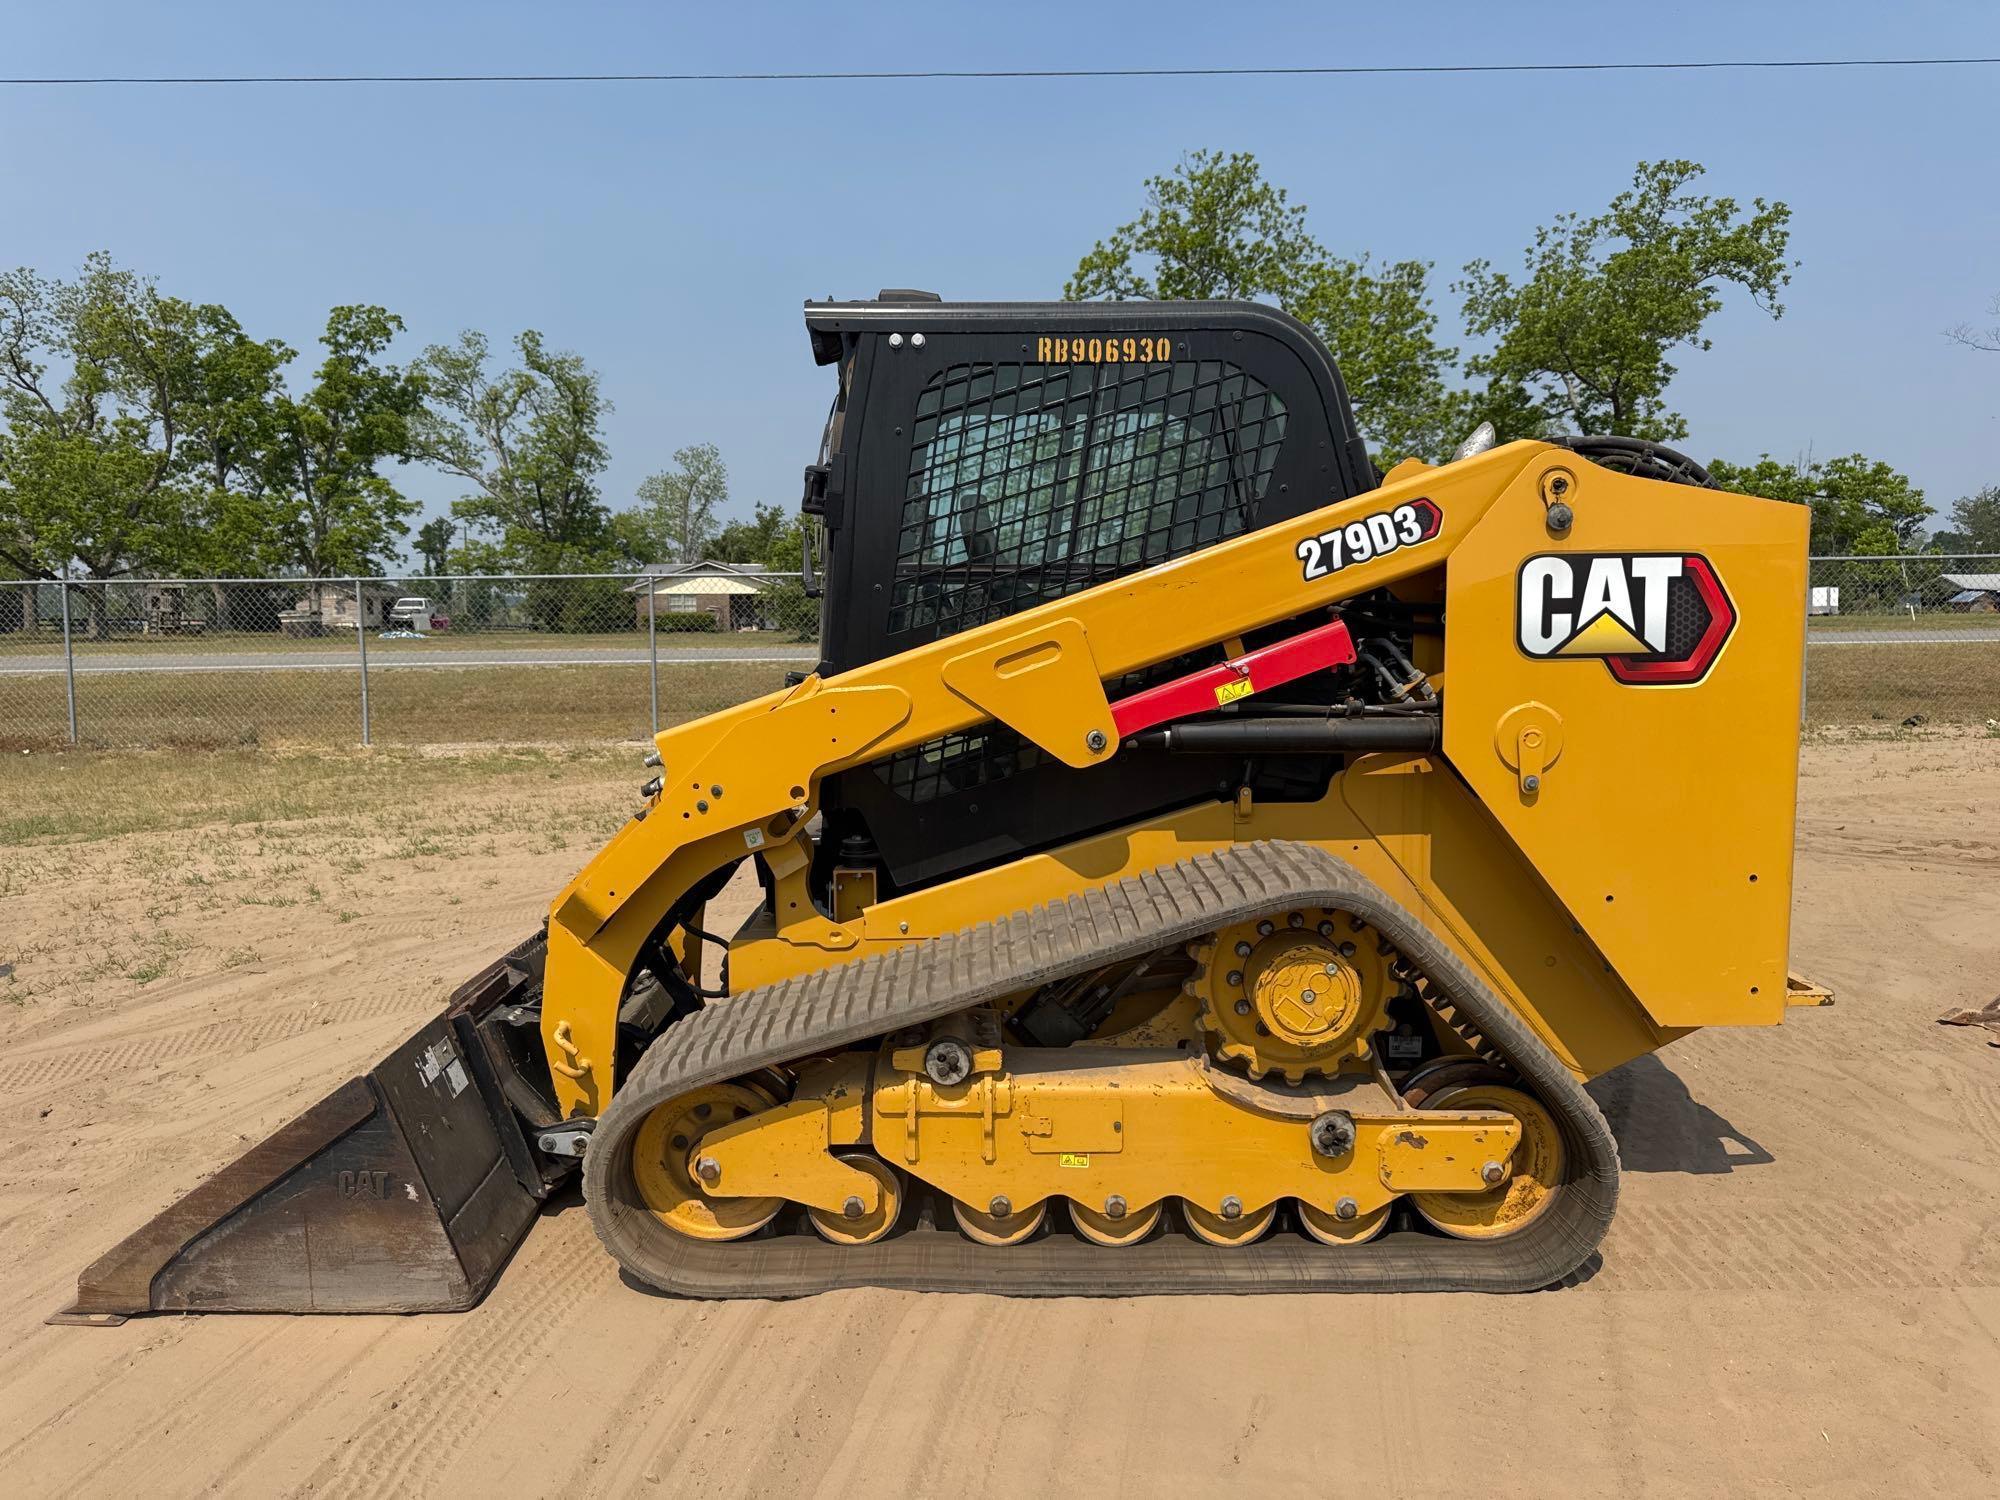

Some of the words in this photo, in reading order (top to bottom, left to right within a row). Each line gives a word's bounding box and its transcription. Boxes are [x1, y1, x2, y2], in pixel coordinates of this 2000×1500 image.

[1037, 337, 1171, 363] RB906930
[1298, 505, 1422, 579] 279D3
[1521, 556, 1683, 654] CAT
[338, 1170, 389, 1200] CAT
